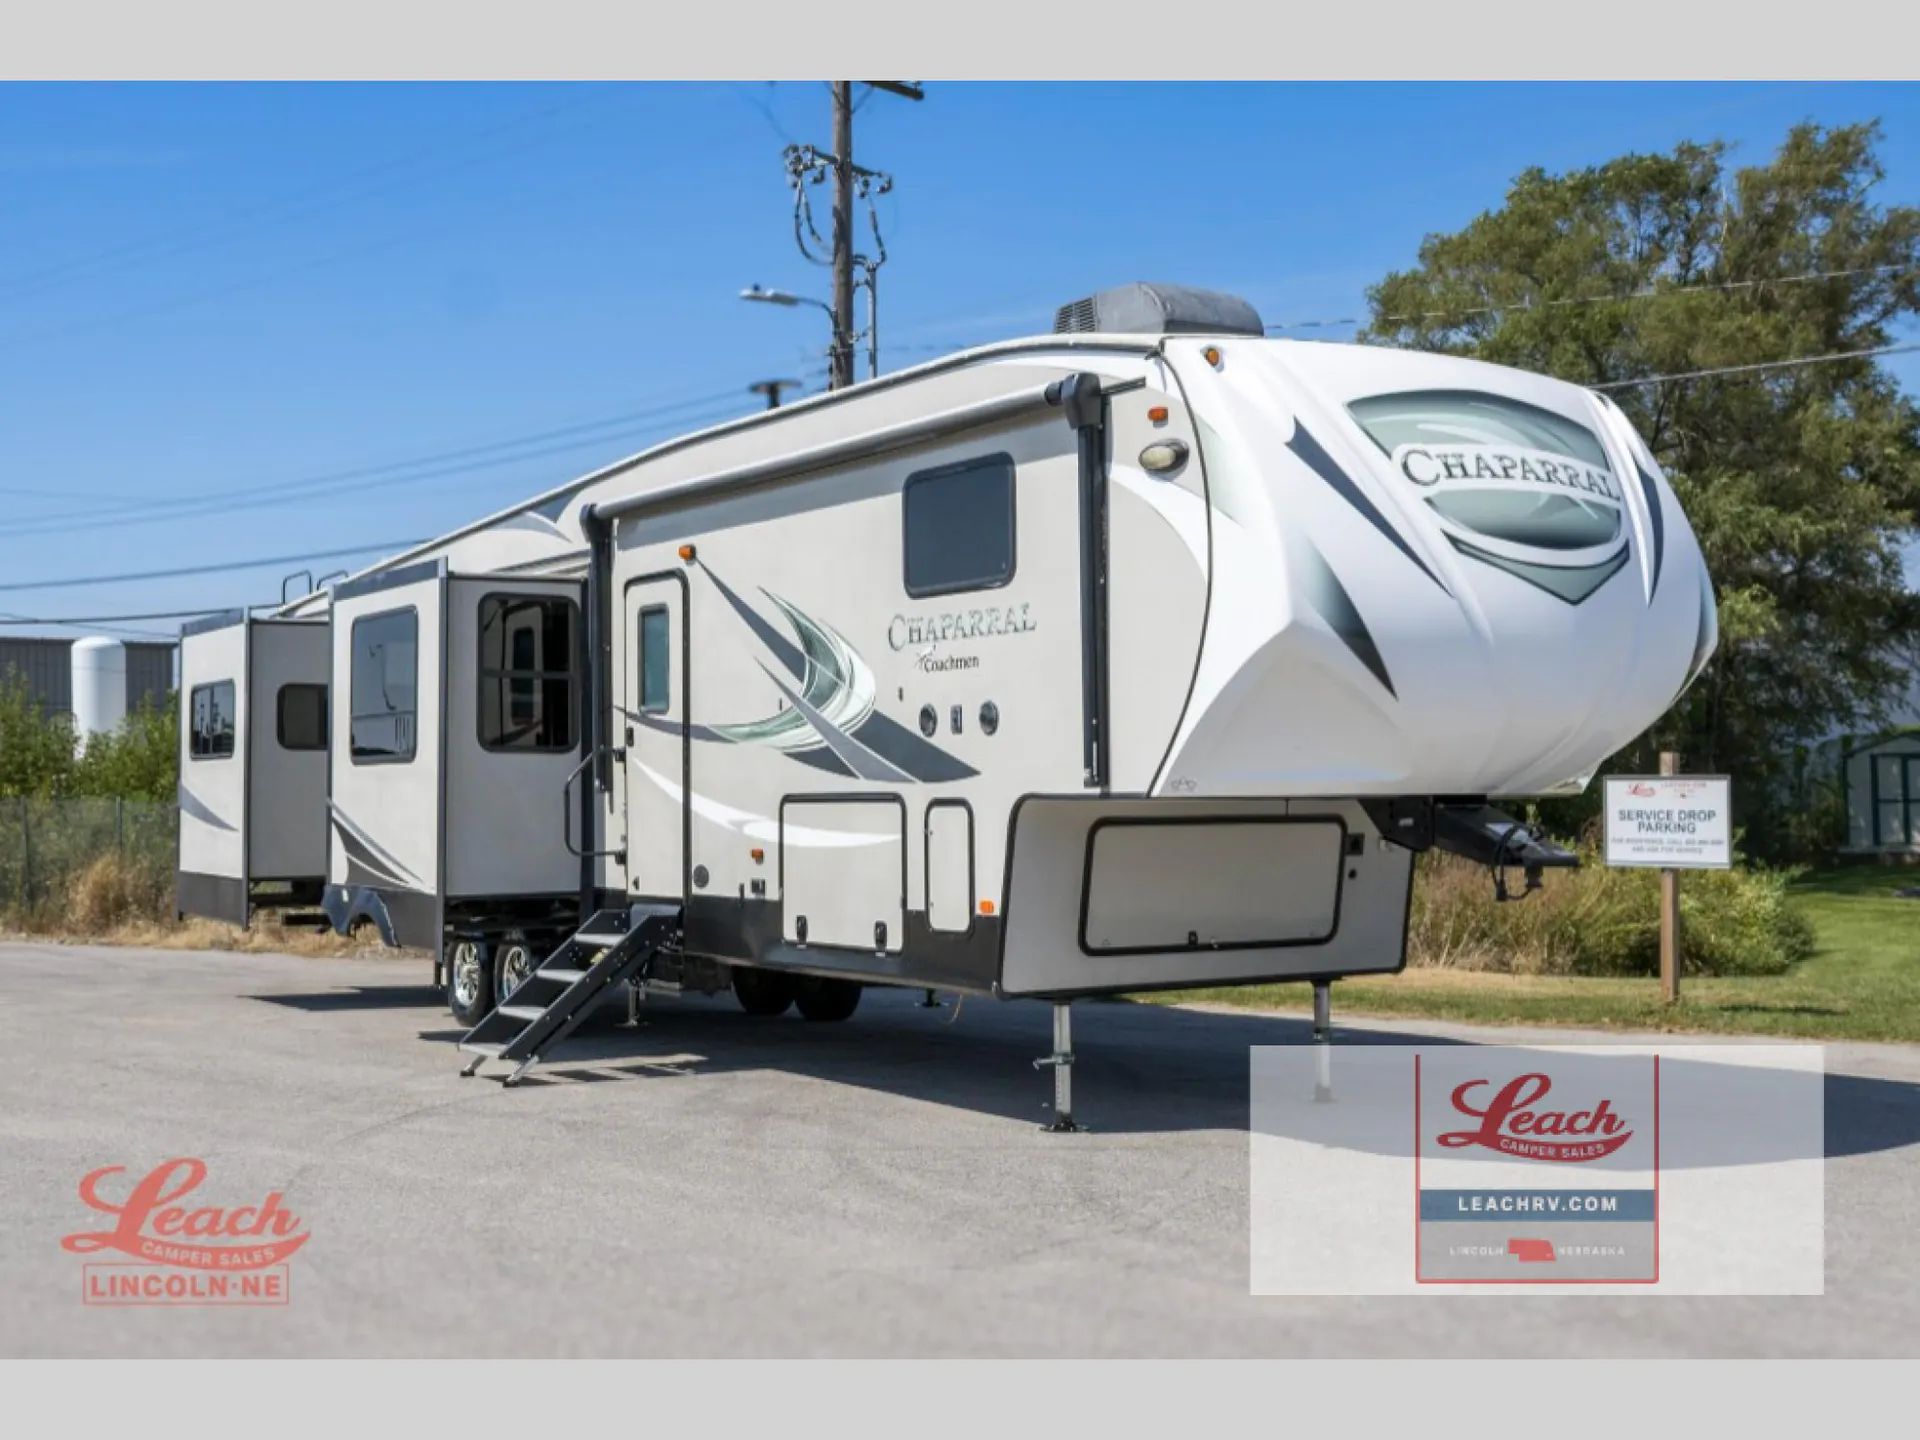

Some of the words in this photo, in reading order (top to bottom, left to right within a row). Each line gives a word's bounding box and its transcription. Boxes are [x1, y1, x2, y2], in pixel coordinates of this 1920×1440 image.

[1401, 449, 1622, 501] CHAPARRAL
[888, 602, 1038, 651] CHAPARRAL
[923, 655, 980, 673] Coachmen
[1618, 809, 1674, 822] SERVICE
[1677, 809, 1717, 822] DROP
[1637, 821, 1697, 834] PARKING
